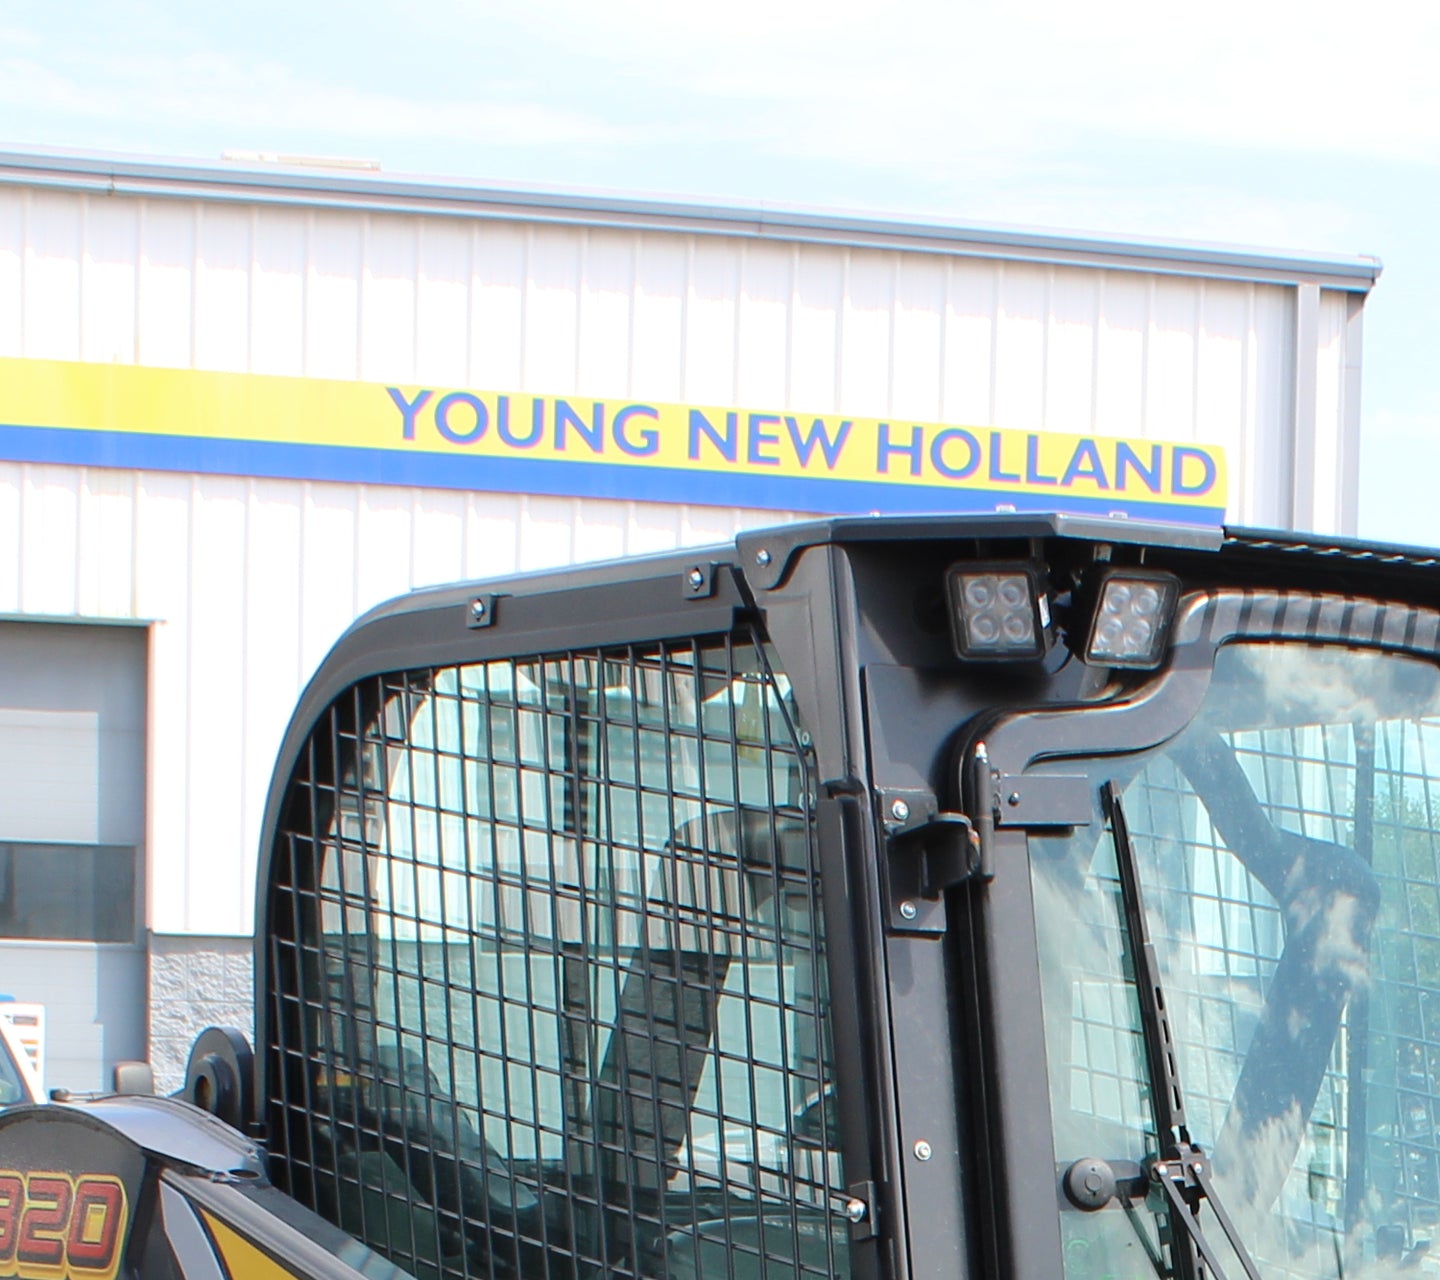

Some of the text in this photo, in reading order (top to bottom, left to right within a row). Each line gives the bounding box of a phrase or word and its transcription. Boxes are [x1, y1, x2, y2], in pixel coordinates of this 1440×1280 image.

[385, 386, 1217, 497] YOUNG NEW HOLLAND
